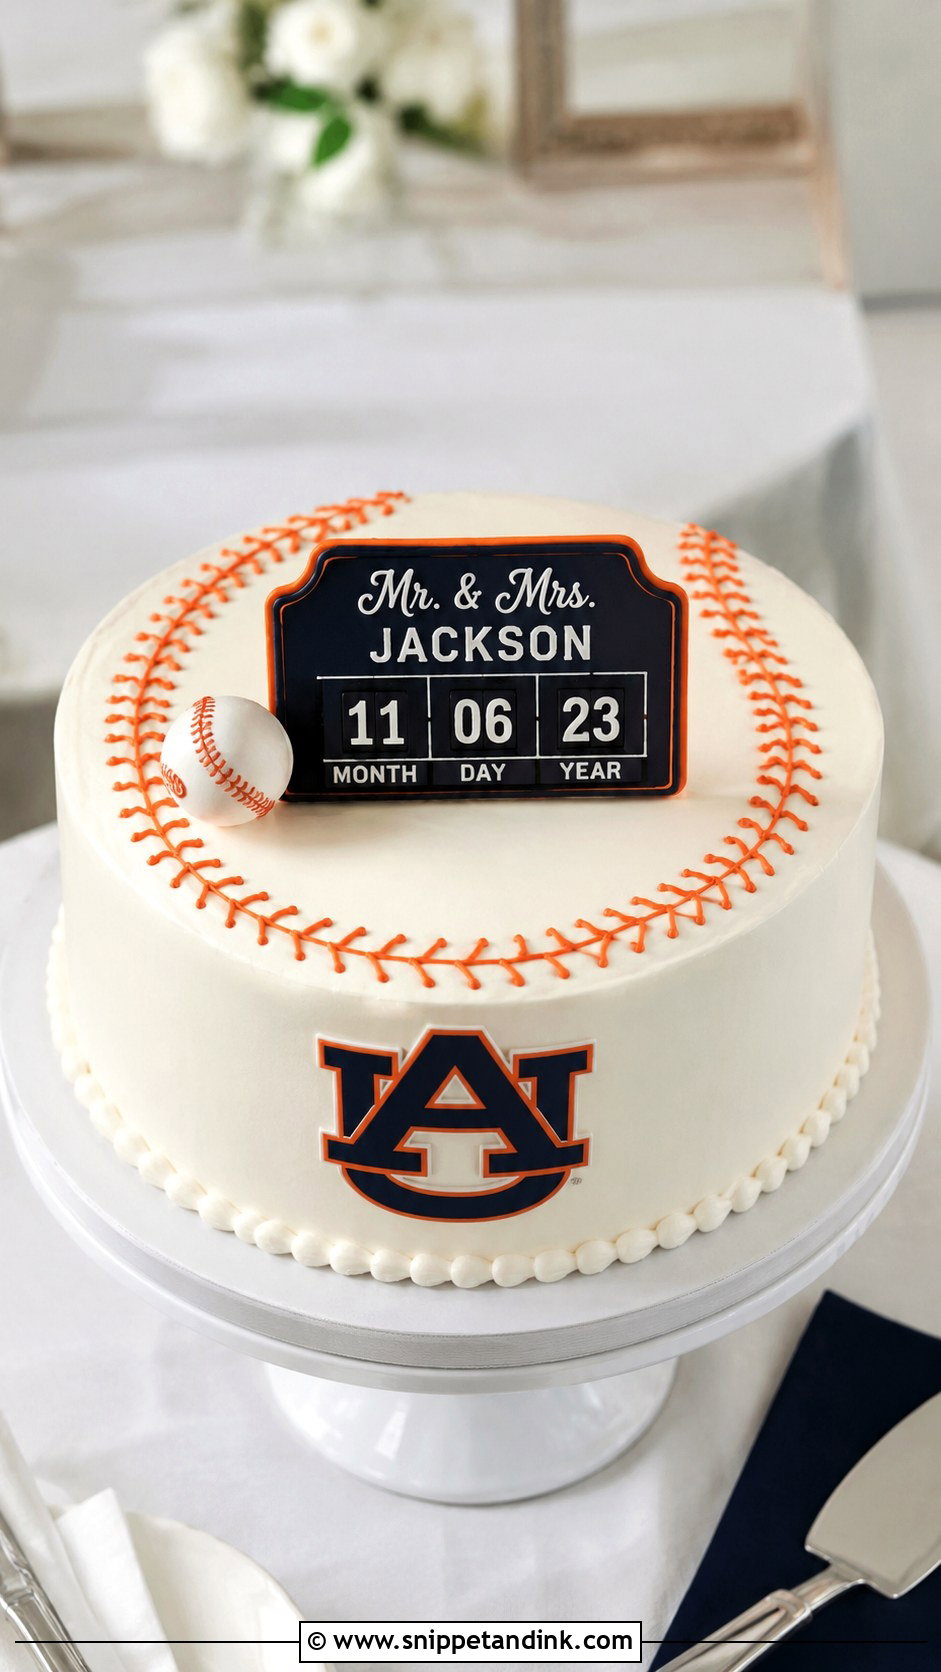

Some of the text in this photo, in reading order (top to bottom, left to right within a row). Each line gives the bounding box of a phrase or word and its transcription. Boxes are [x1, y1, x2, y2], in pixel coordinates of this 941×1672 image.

[358, 567, 596, 617] Mr. & Mrs.
[369, 625, 591, 663] JACKSON
[348, 696, 620, 746] 11 06 23
[333, 762, 621, 784] MONTH DAY YEAR
